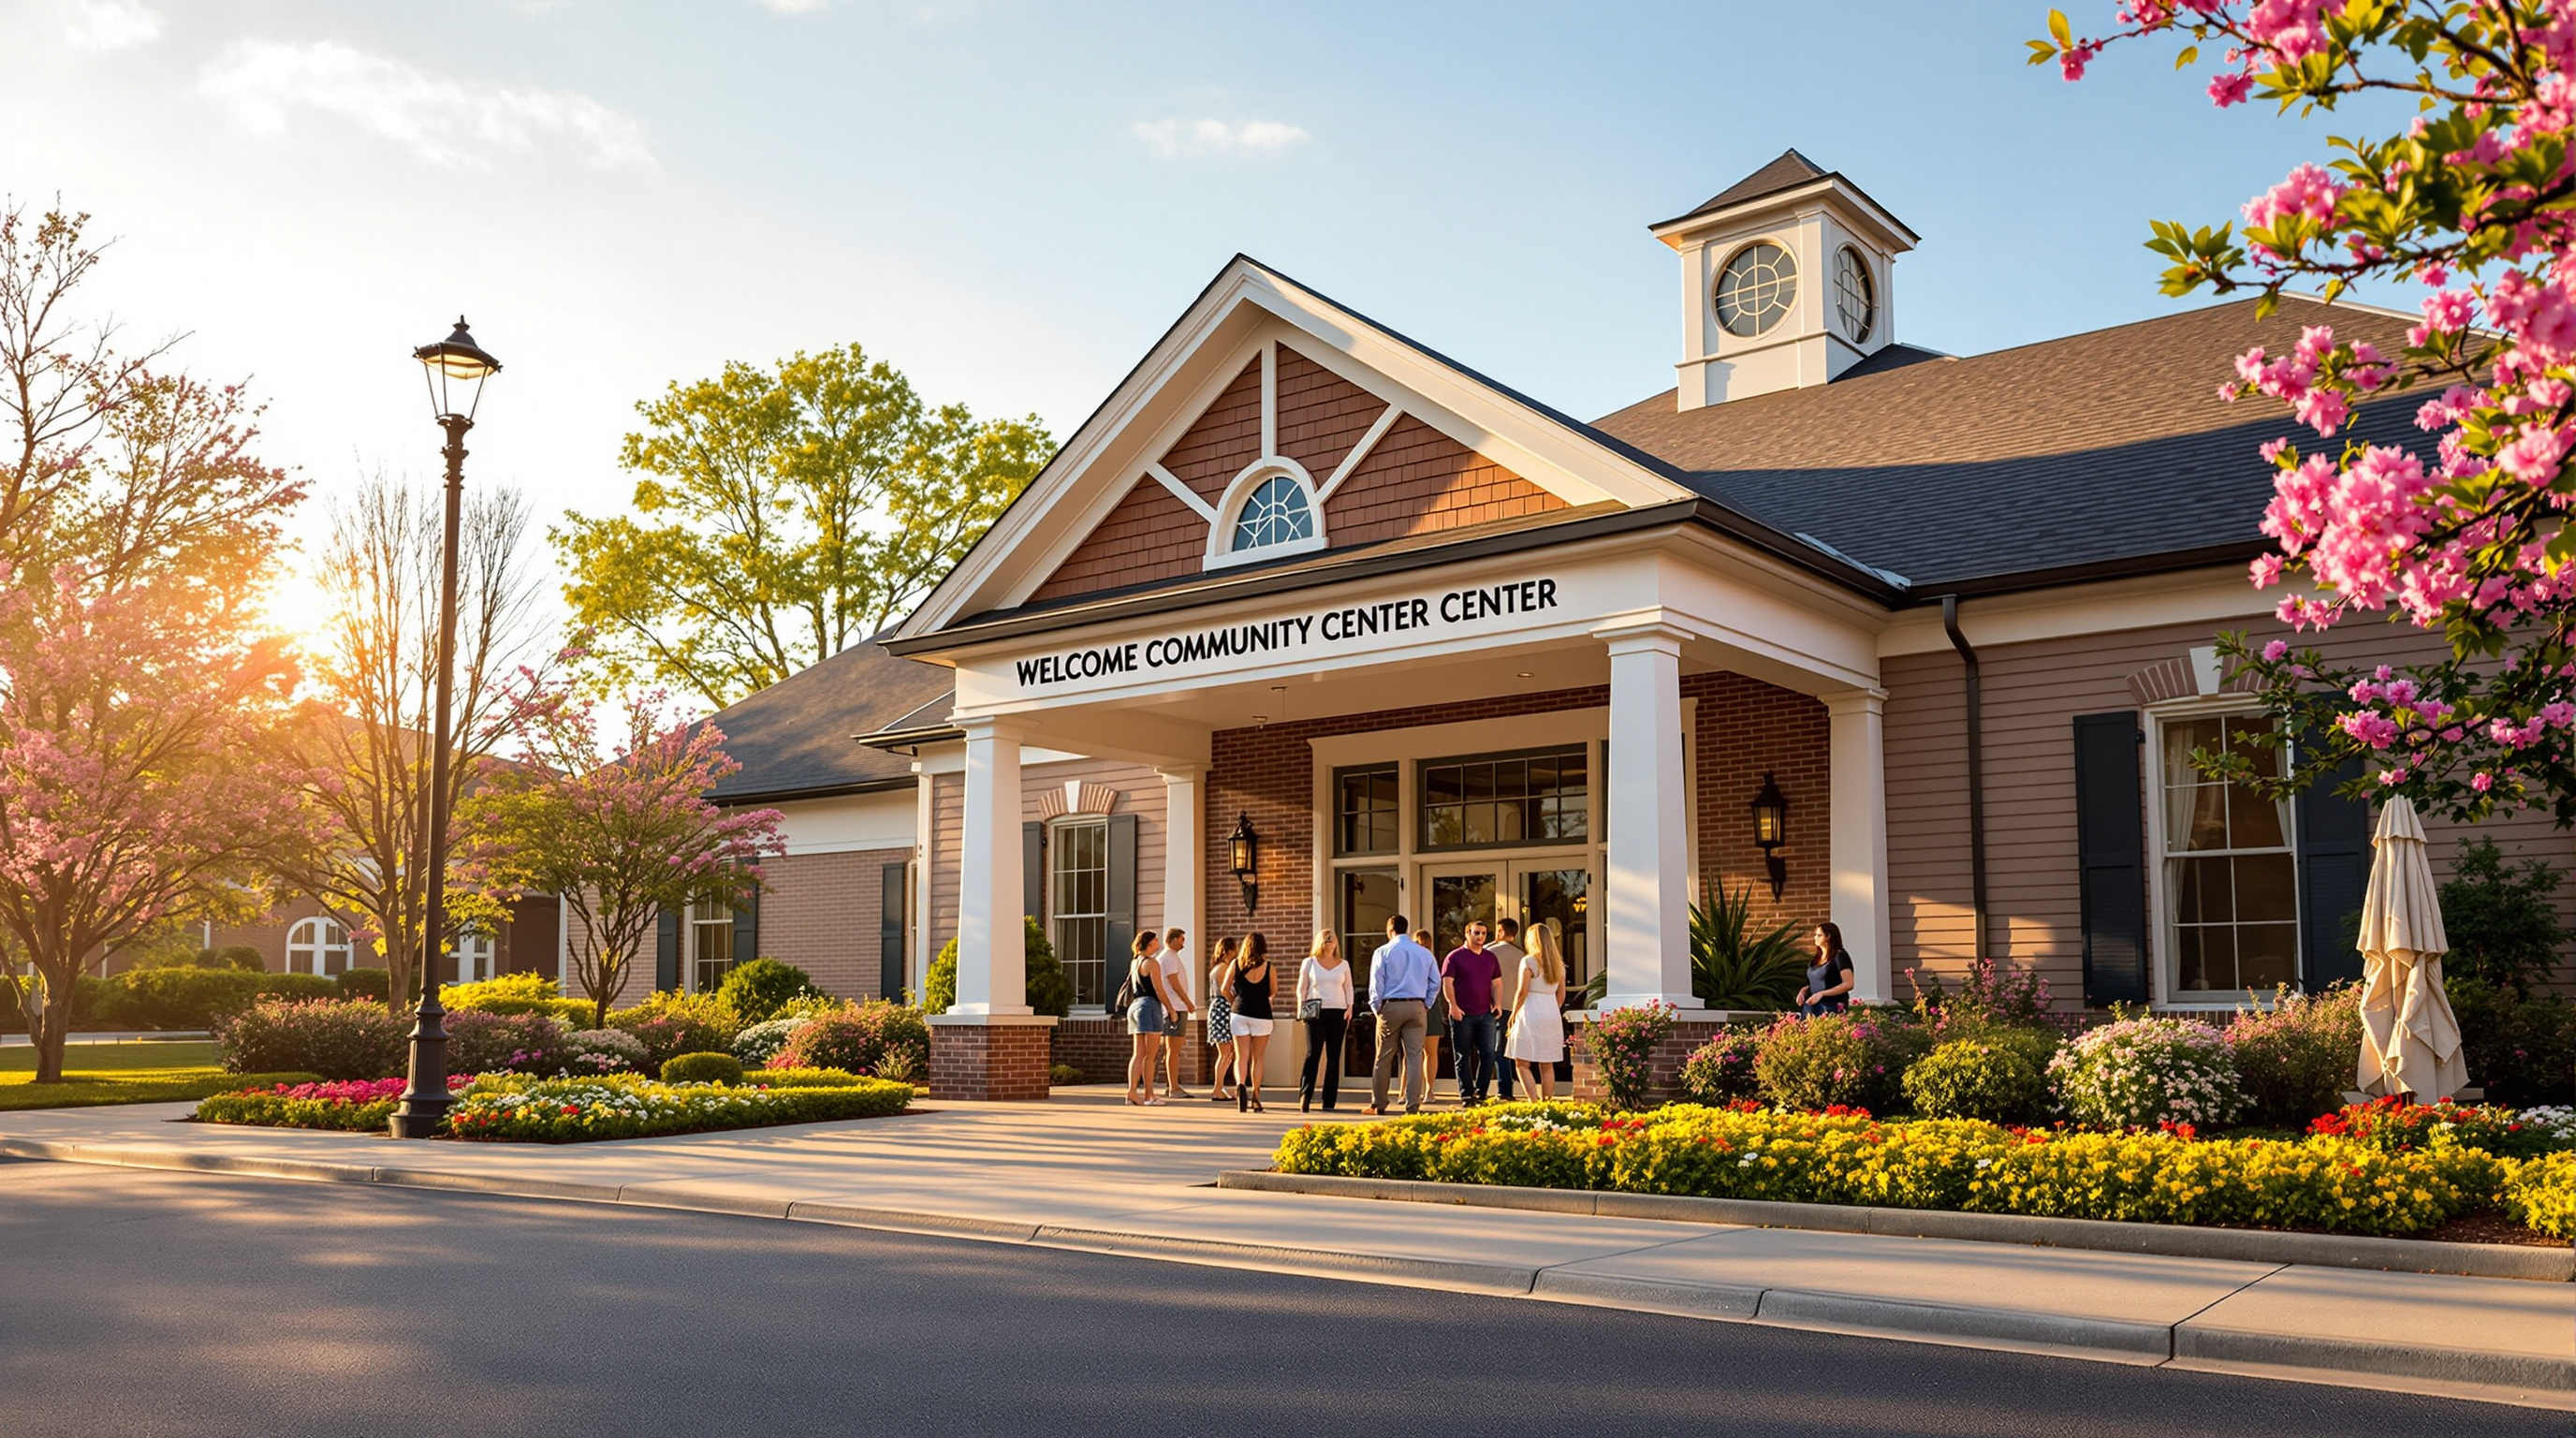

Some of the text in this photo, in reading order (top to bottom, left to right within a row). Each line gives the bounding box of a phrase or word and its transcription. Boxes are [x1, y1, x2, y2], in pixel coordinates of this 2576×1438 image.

[1016, 579, 1558, 687] WELCOME COMMUNITY CENTER CENTER
